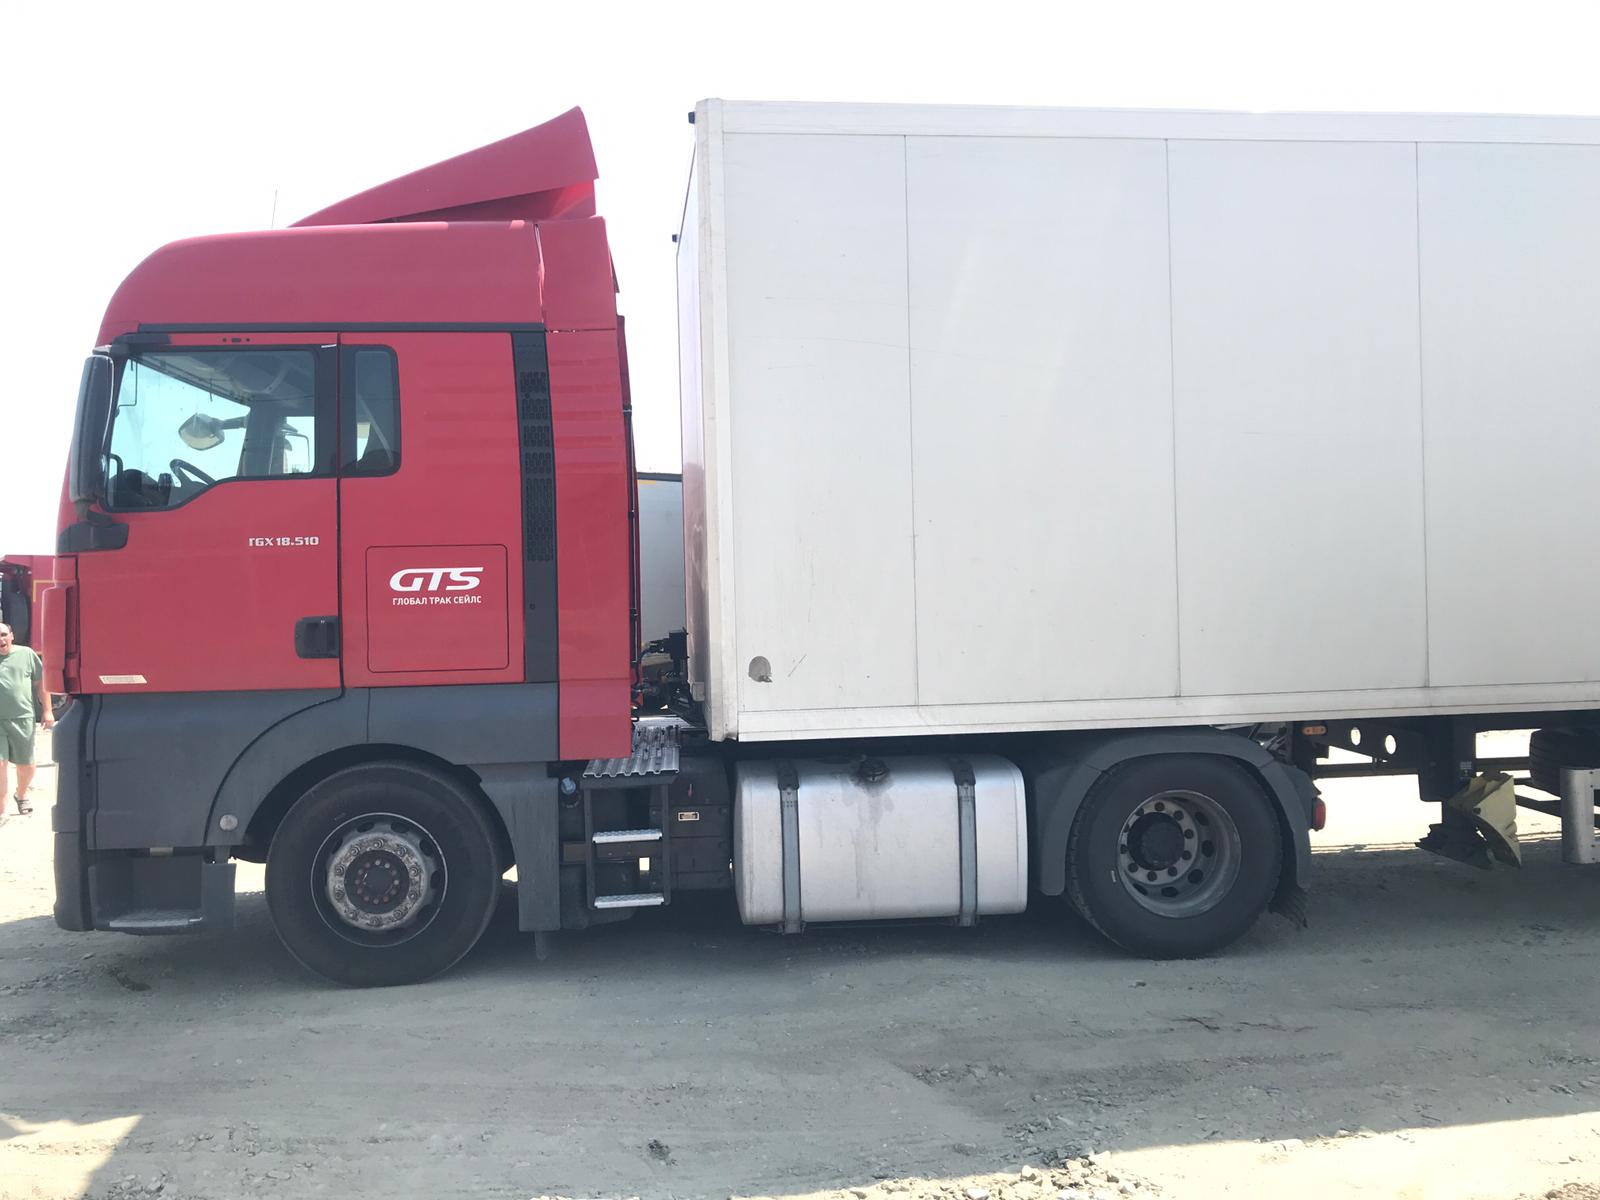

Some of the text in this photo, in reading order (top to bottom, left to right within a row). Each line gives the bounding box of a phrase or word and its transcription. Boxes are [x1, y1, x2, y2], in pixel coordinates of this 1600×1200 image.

[276, 536, 319, 546] 18.510
[389, 567, 484, 592] GTS
[392, 594, 482, 606] ГЛОБАЛ ТРАК СЕЙЛС
